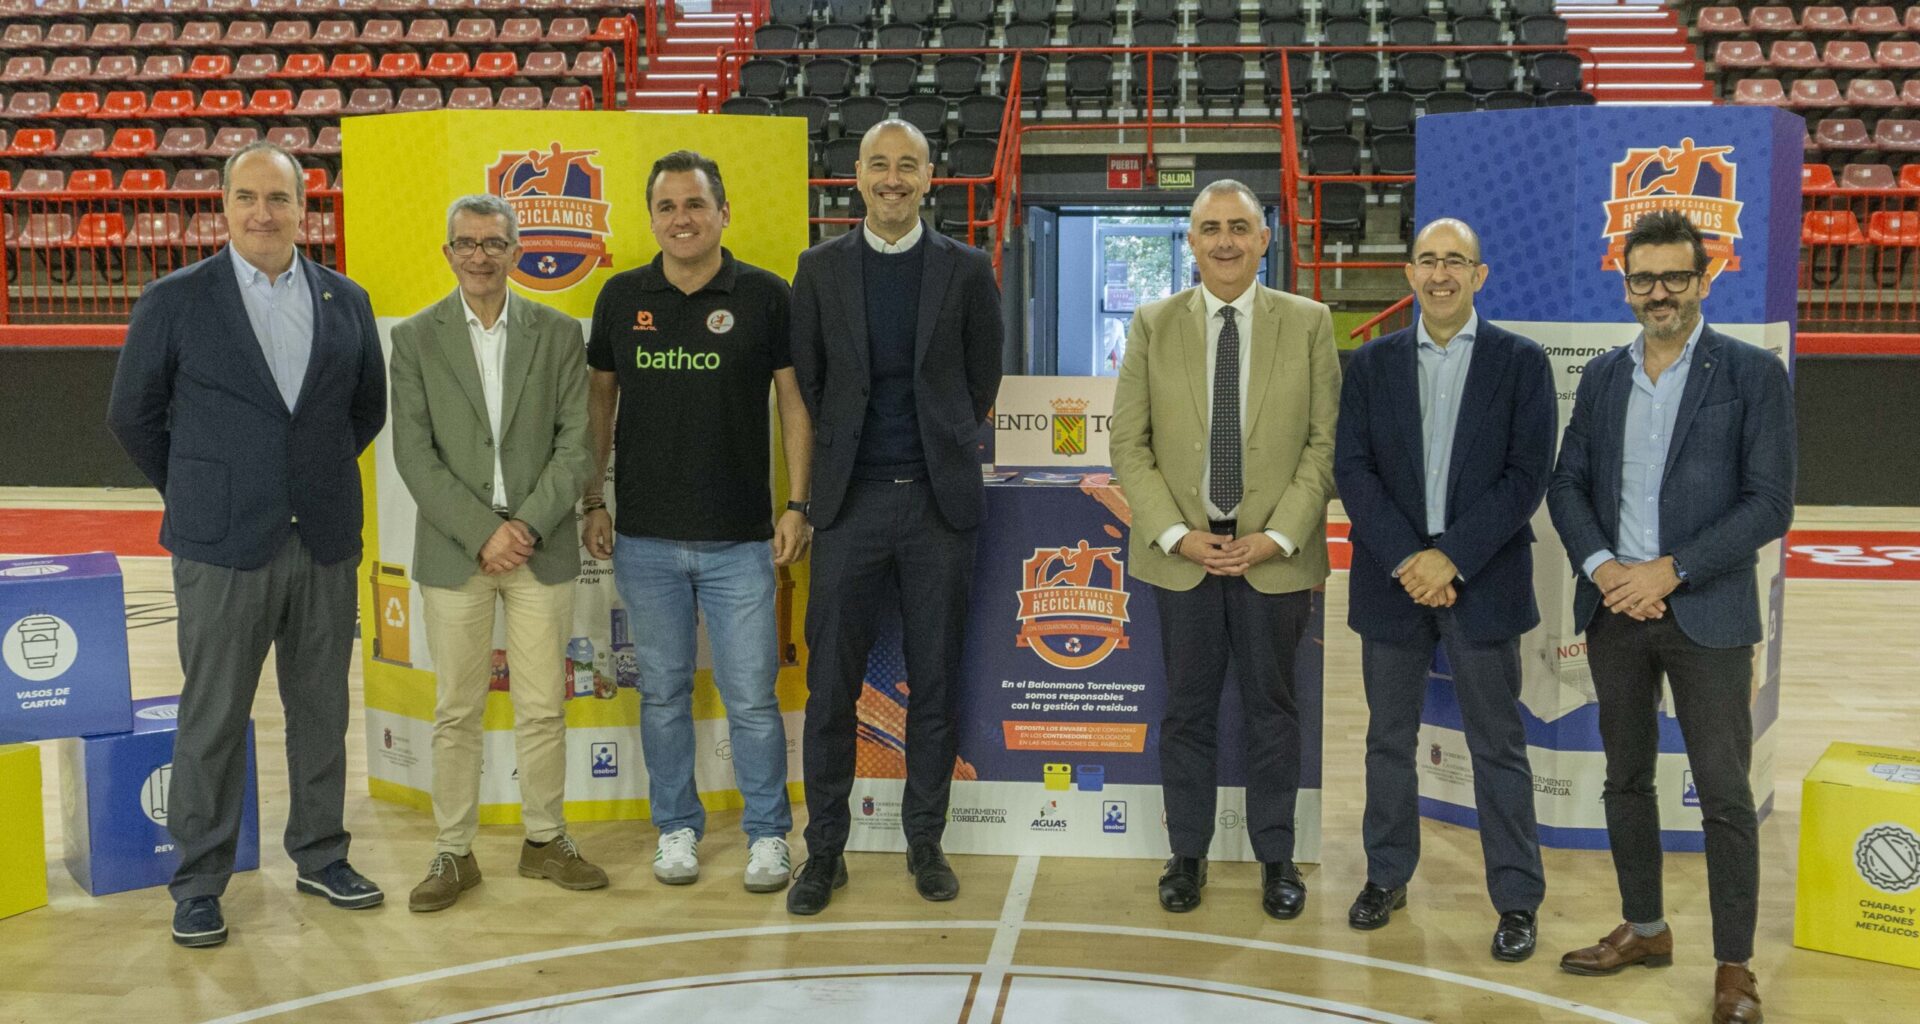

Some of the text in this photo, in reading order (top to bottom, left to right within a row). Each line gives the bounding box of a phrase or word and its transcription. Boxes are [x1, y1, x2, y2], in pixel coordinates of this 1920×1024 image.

[1111, 160, 1139, 170] PUERTA
[1121, 173, 1128, 184] 5
[1161, 173, 1191, 184] SALIDA
[511, 199, 593, 213] MOS ESPECIALES
[1624, 200, 1723, 213] SOMOS ESPECIALES
[518, 209, 593, 228] CICLAMOS
[1623, 207, 1722, 229] REMOS
[636, 345, 721, 370] bathco
[1567, 365, 1584, 374] co
[1556, 390, 1576, 400] osit
[580, 577, 600, 585] FILM
[1033, 590, 1114, 601] SOMOS ESPECIALES
[1033, 598, 1113, 614] RECICLAMOS
[1557, 643, 1587, 660] NOT
[1001, 680, 1146, 692] En el Balonmano Torrelavega
[16, 687, 70, 699] VASOS DE
[1025, 692, 1124, 703] somos responsables
[21, 697, 67, 710] CARTÓN
[1011, 702, 1139, 712] con la gestión de residuos
[593, 767, 617, 775] asobal
[1533, 775, 1573, 787] TAMIENTO
[1533, 784, 1571, 796] ELAVEGA
[951, 807, 1007, 816] AYUNTAMIENTO
[952, 815, 1006, 824] TORRELAVEGA
[1031, 819, 1067, 828] AGUAS
[154, 844, 175, 854] REV
[1859, 899, 1916, 915] CHAPAS Y
[1862, 910, 1915, 926] TAPONES
[1856, 920, 1920, 939] METÁLICOS
